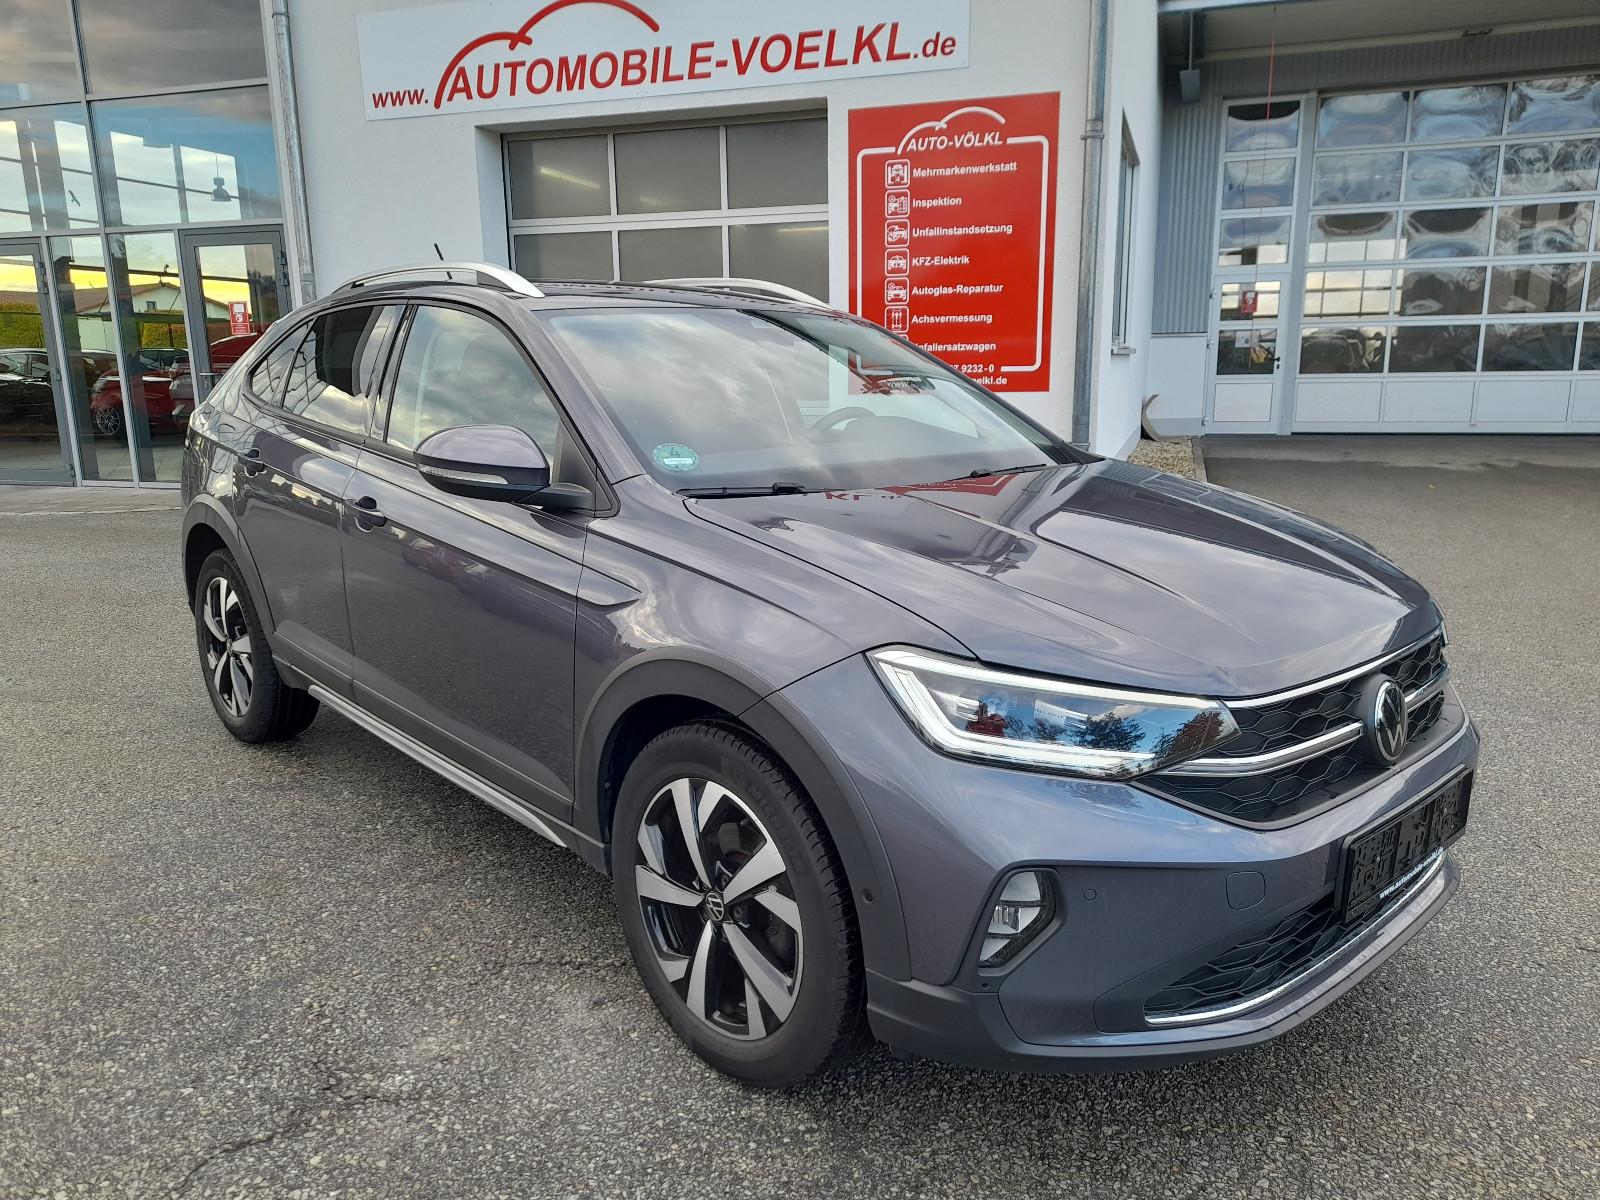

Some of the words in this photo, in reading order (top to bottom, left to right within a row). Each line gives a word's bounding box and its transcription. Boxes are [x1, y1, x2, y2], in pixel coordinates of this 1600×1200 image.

[372, 88, 429, 108] www.
[906, 131, 1003, 152] AUTO-VÖLKL
[912, 161, 1018, 178] Mehrmarkenwerkstatt
[912, 197, 962, 209] Inspektion
[911, 224, 1013, 237] Unfallinstandsetzung
[911, 255, 970, 266] KFZ-Elektrik
[911, 284, 1004, 297] Autoglas-Reparatur
[911, 313, 993, 325] Achsvermessung
